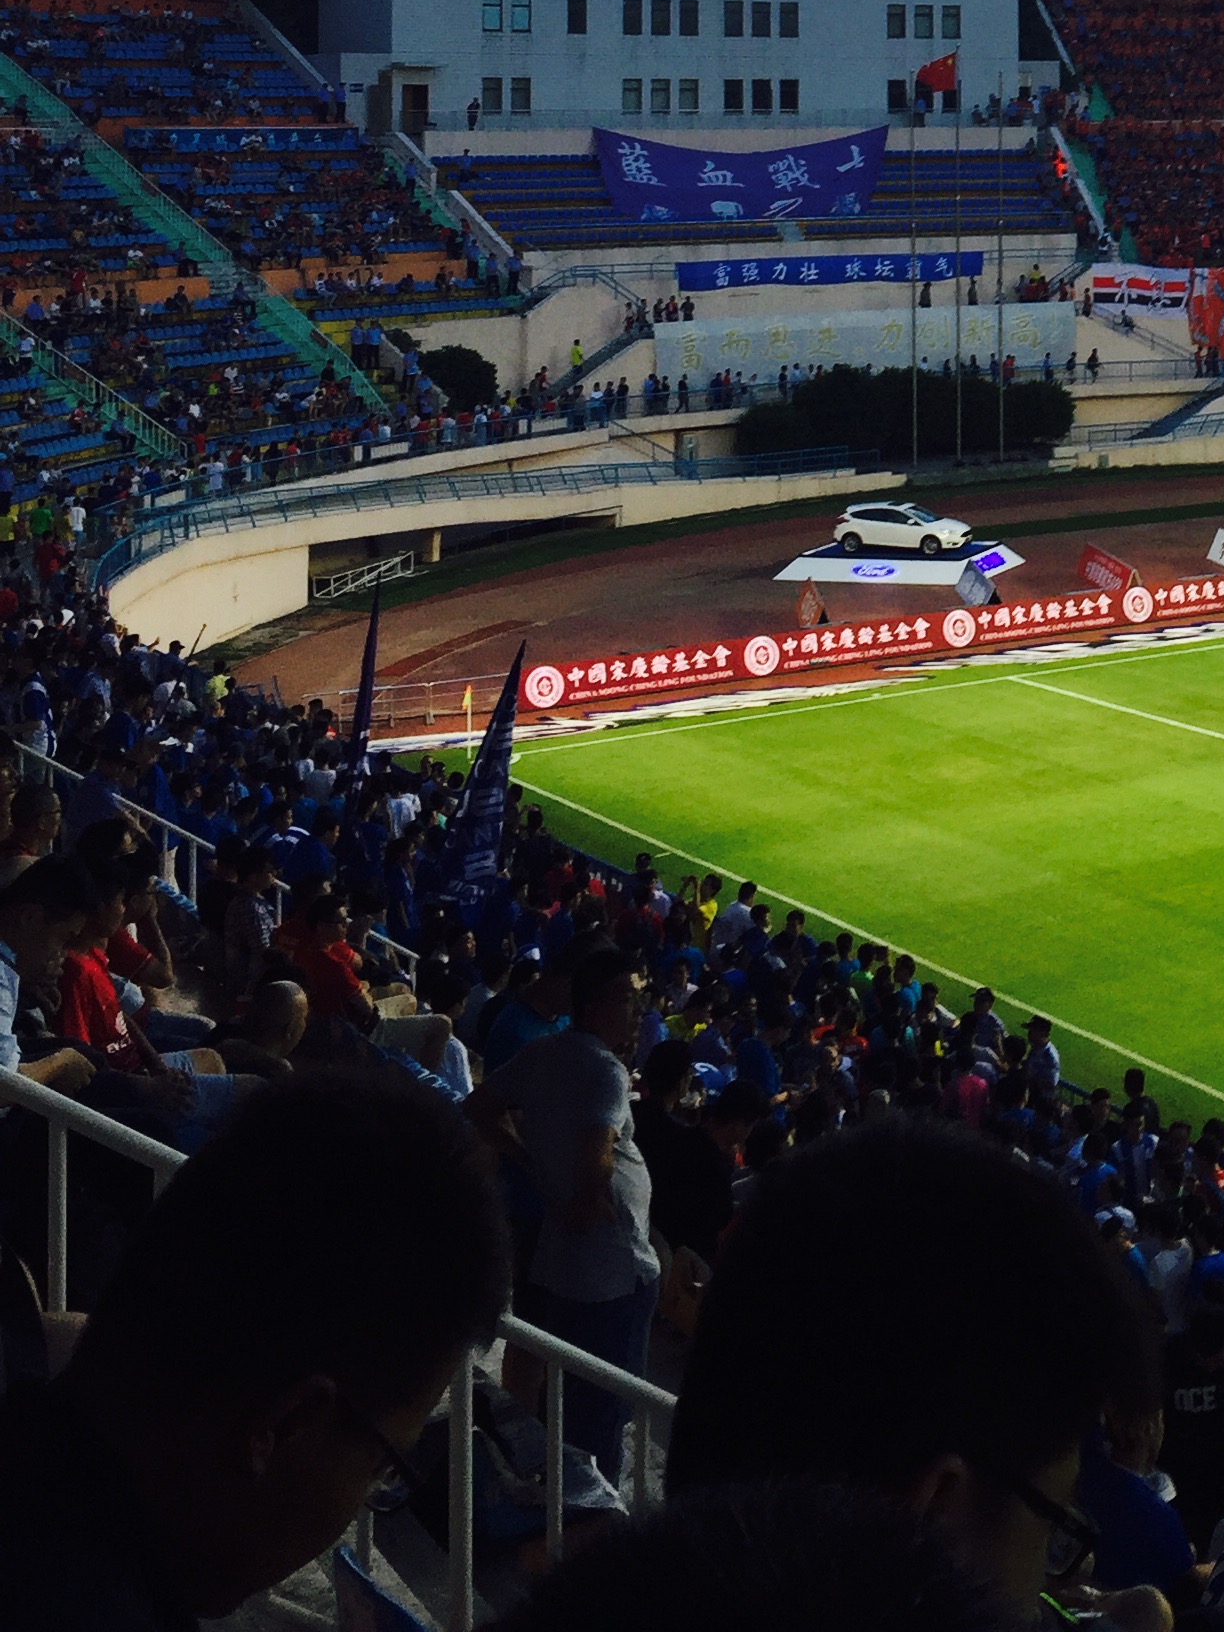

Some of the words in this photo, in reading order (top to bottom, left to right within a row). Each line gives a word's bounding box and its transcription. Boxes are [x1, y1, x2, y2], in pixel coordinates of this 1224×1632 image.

[567, 644, 732, 688] 中國宋慶齡基金會
